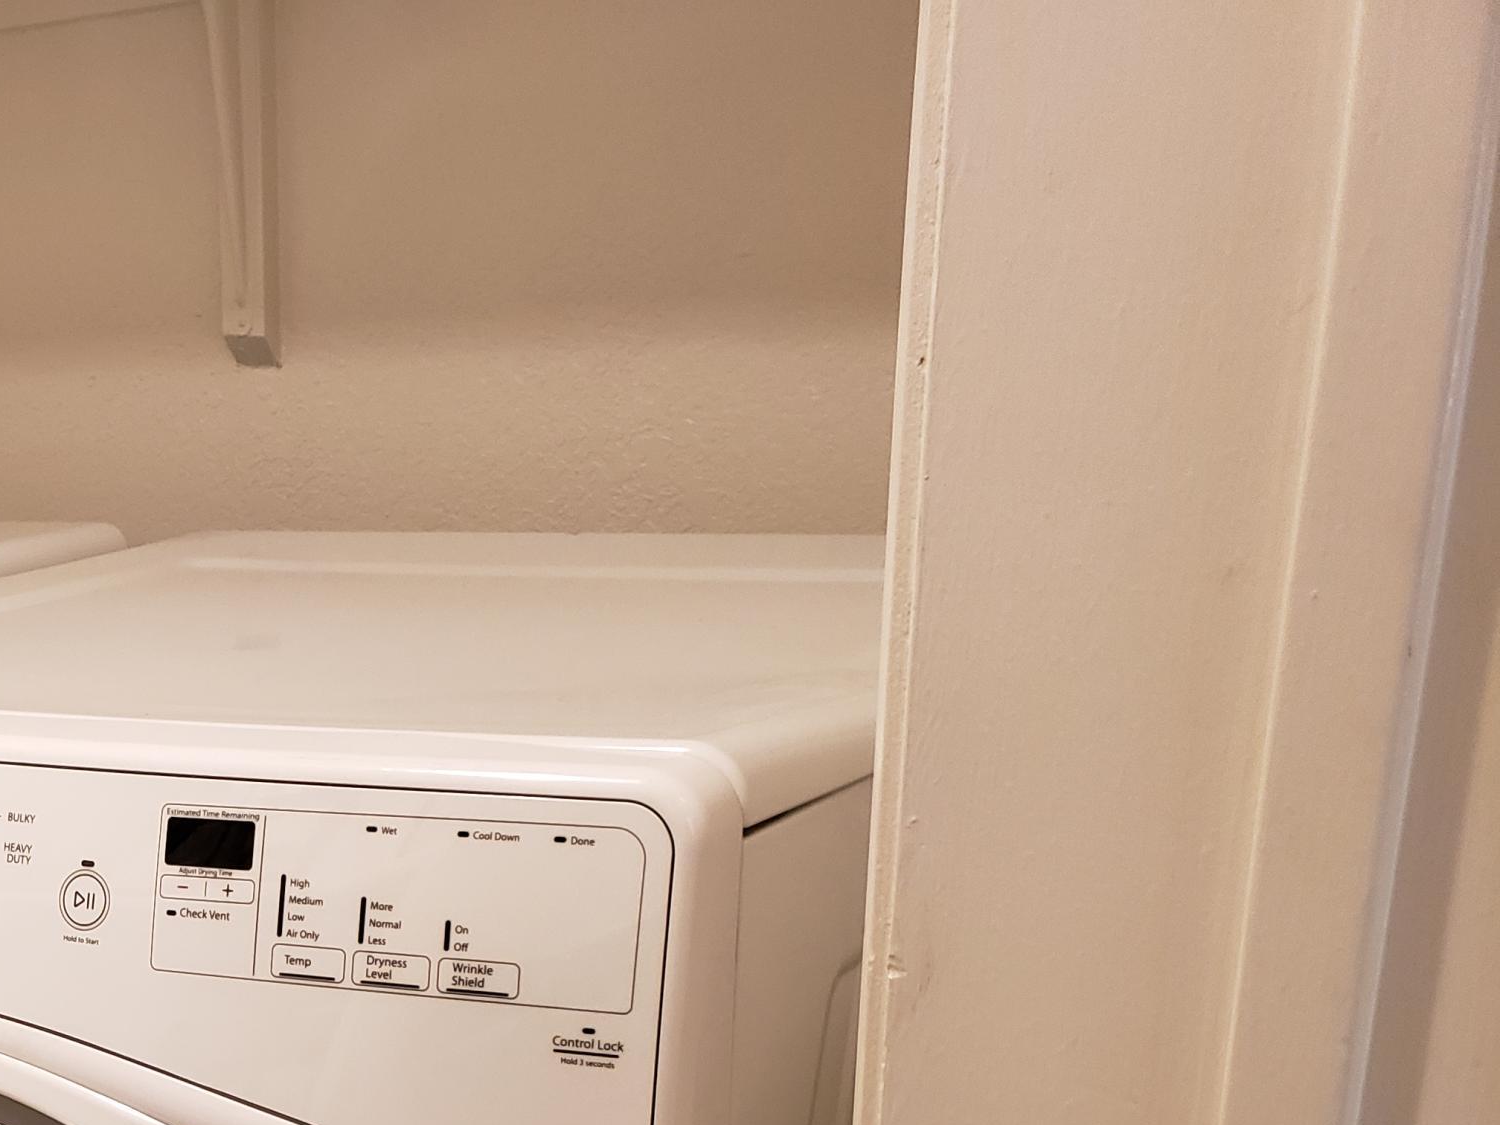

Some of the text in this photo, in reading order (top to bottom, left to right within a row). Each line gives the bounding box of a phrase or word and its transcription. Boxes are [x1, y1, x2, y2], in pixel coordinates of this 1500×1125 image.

[7, 812, 36, 824] BULKY
[166, 808, 261, 822] Estimated Time Remaining
[381, 826, 398, 836] Wet
[472, 831, 521, 843] Cool Down
[570, 836, 596, 847] Done
[3, 842, 33, 854] HEAVY
[6, 853, 32, 865] DUTY
[179, 867, 233, 878] Adjust Drying Time
[290, 878, 311, 890] High
[288, 895, 324, 907] Medium
[370, 901, 394, 912] More
[179, 907, 231, 921] Check Vent
[287, 912, 306, 922] Low
[368, 918, 402, 930] Normal
[454, 924, 469, 935] On
[62, 935, 77, 943] Hold
[85, 937, 100, 945] Start
[286, 929, 320, 942] Air Only
[367, 936, 387, 946] Less
[453, 942, 469, 953] Off
[284, 954, 312, 968] Temp
[366, 954, 408, 970] Dryness
[365, 968, 393, 981] Level
[452, 962, 494, 977] Wrinkle
[451, 975, 485, 989] Shield
[552, 1035, 624, 1053] Control Lock
[560, 1056, 578, 1067] Hold
[585, 1060, 616, 1070] seconds
